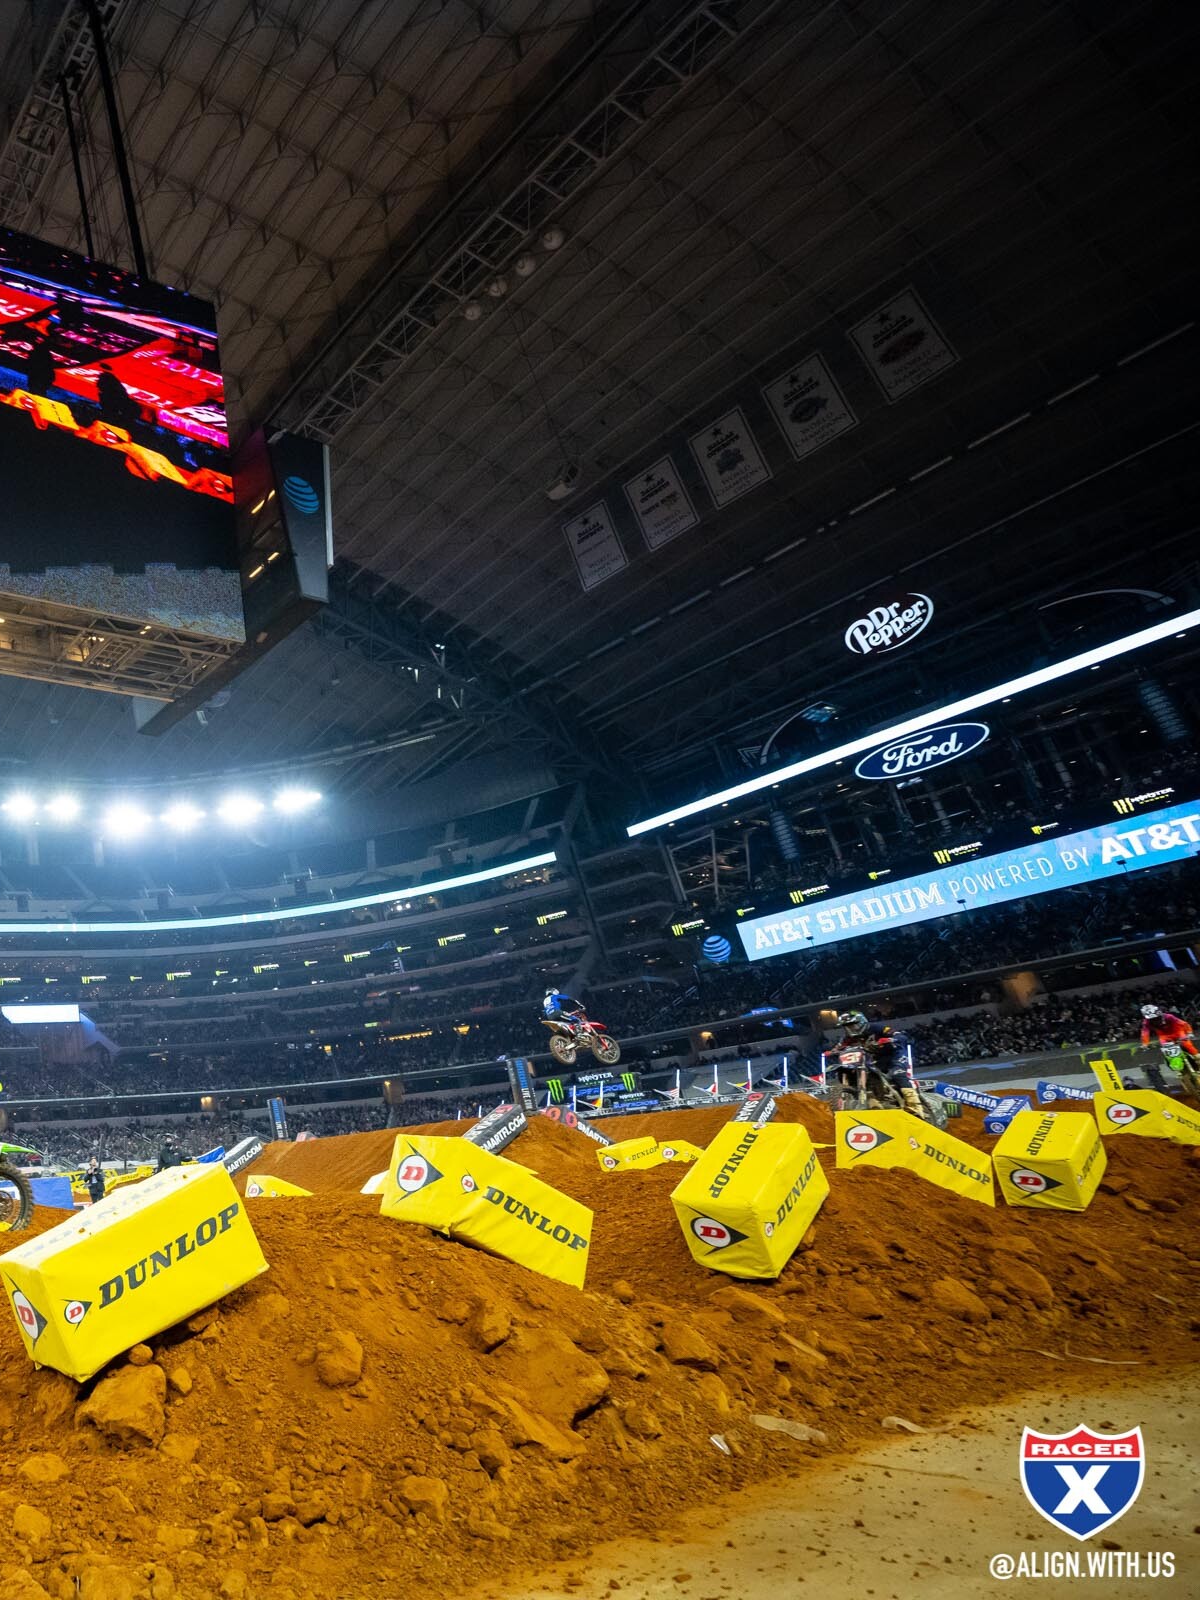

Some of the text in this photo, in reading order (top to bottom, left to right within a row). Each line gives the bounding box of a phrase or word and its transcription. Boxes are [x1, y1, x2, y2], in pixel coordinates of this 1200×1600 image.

[867, 602, 900, 629] Dr
[882, 732, 963, 774] Ford
[755, 813, 1200, 950] AT&T STADIUM POWERED BY AT&T
[955, 1090, 999, 1110] YAMAHA
[1058, 1084, 1095, 1101] YAMAH
[1026, 1119, 1055, 1157] DUNLOP
[709, 1131, 759, 1199] DUNLOP
[923, 1143, 992, 1186] DUNLOP
[776, 1150, 818, 1226] DUNLOP
[482, 1185, 588, 1252] DUNLOP
[99, 1202, 240, 1310] DUNLOP
